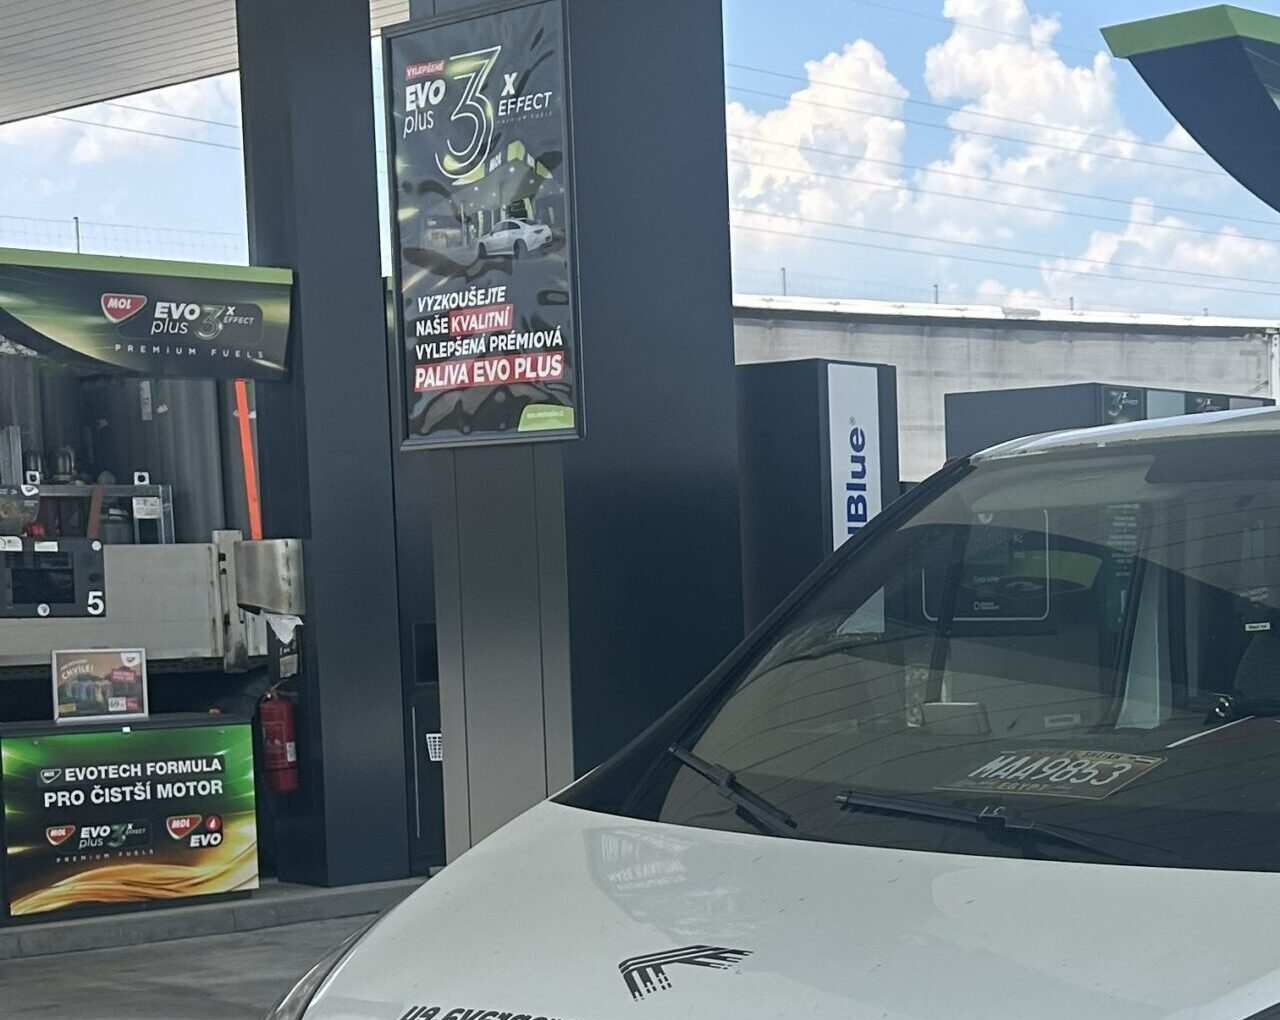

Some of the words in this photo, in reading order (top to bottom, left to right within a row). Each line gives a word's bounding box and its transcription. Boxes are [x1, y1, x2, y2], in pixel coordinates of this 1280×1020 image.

[405, 79, 447, 112] EVO
[501, 72, 518, 97] X
[435, 45, 502, 178] 3
[498, 91, 553, 116] EFFECT
[403, 108, 435, 139] plus
[107, 297, 132, 310] MOL
[154, 301, 201, 321] EVO
[417, 285, 507, 313] VYZKOUŠEJTE
[150, 317, 189, 336] plus
[194, 304, 226, 341] 3
[223, 316, 255, 325] EFFECT
[416, 315, 449, 337] NAŠE
[451, 306, 511, 333] KVALITNÍ
[114, 344, 197, 356] PREMIUM
[211, 348, 264, 359] FUELS
[415, 334, 487, 361] VYLEPŠENÁ
[489, 325, 564, 352] PRÉMIOVÁ
[415, 362, 469, 389] PALIVA
[473, 358, 511, 384] EVO
[514, 354, 562, 379] PLUS
[846, 427, 868, 535] Blue
[86, 591, 105, 615] 5
[64, 763, 142, 782] EVOTECH
[146, 758, 223, 776] FORMULA
[968, 755, 1132, 785] MAA9853
[44, 790, 85, 808] PRO
[90, 781, 151, 804] ČISTŠÍ
[156, 780, 224, 799] MOTOR
[999, 781, 1049, 791] EGYPT
[80, 825, 111, 839] EVO
[171, 819, 190, 829] MOL
[78, 836, 104, 850] plus
[190, 833, 222, 848] EVO
